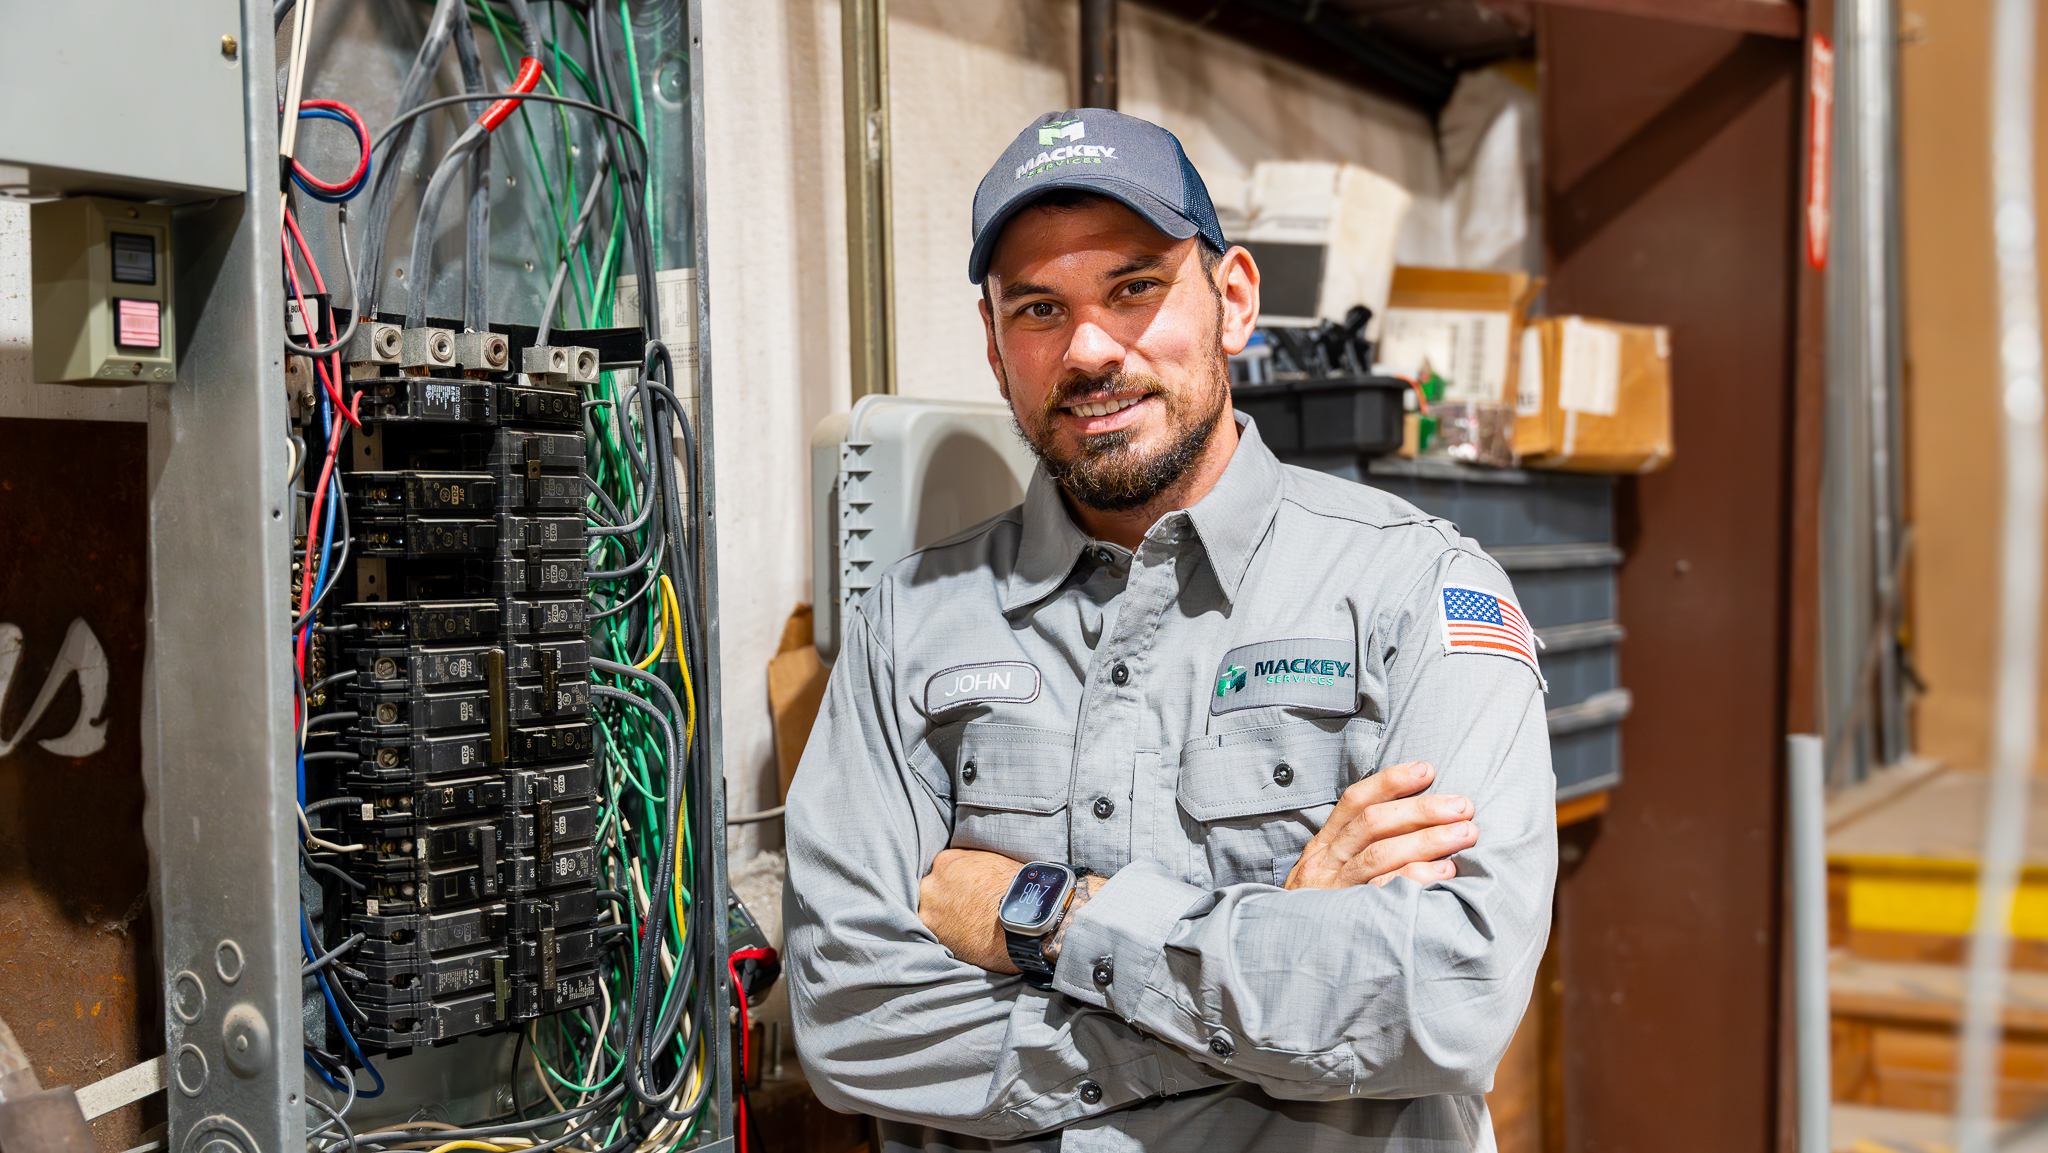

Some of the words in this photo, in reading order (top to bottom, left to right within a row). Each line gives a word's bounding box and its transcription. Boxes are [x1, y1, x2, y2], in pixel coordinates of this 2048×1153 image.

[1015, 144, 1116, 180] MACKEY
[1027, 157, 1102, 179] SERVICES
[451, 485, 459, 505] 20A
[459, 658, 467, 678] 20A
[1255, 658, 1351, 677] MACKEY
[945, 672, 1011, 697] JOHN
[1266, 674, 1334, 687] SERVICES
[460, 701, 468, 721] 20A
[461, 744, 469, 765] 20A
[560, 857, 568, 876] 20A
[486, 879, 494, 888] 15
[1019, 882, 1051, 907] 2:08
